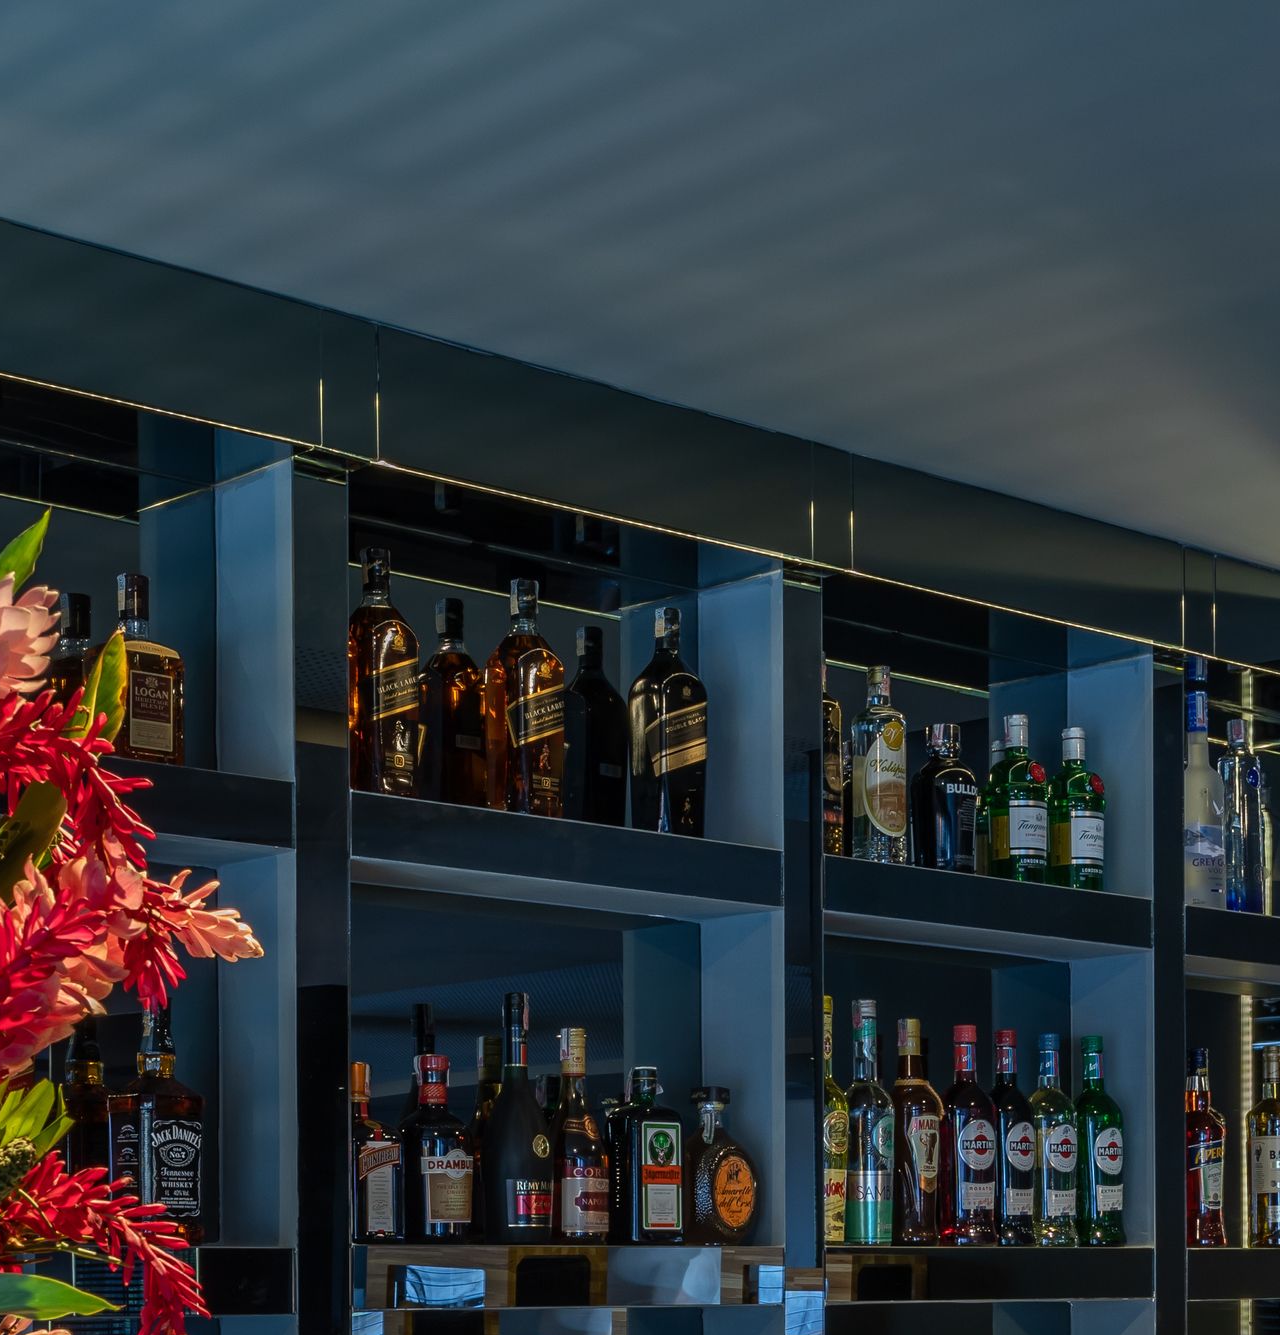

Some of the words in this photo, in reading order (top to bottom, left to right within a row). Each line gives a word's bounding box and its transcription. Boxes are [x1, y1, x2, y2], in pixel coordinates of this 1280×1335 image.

[135, 687, 169, 700] LOGAN
[378, 684, 399, 695] BLACK
[524, 708, 546, 720] BLACK
[1192, 858, 1216, 866] GREY
[151, 1129, 173, 1148] JACK
[172, 1125, 202, 1150] DANIEL'S
[160, 1167, 195, 1177] Tennessee
[161, 1181, 194, 1189] WHISKEY
[516, 1180, 540, 1191] RÉMY
